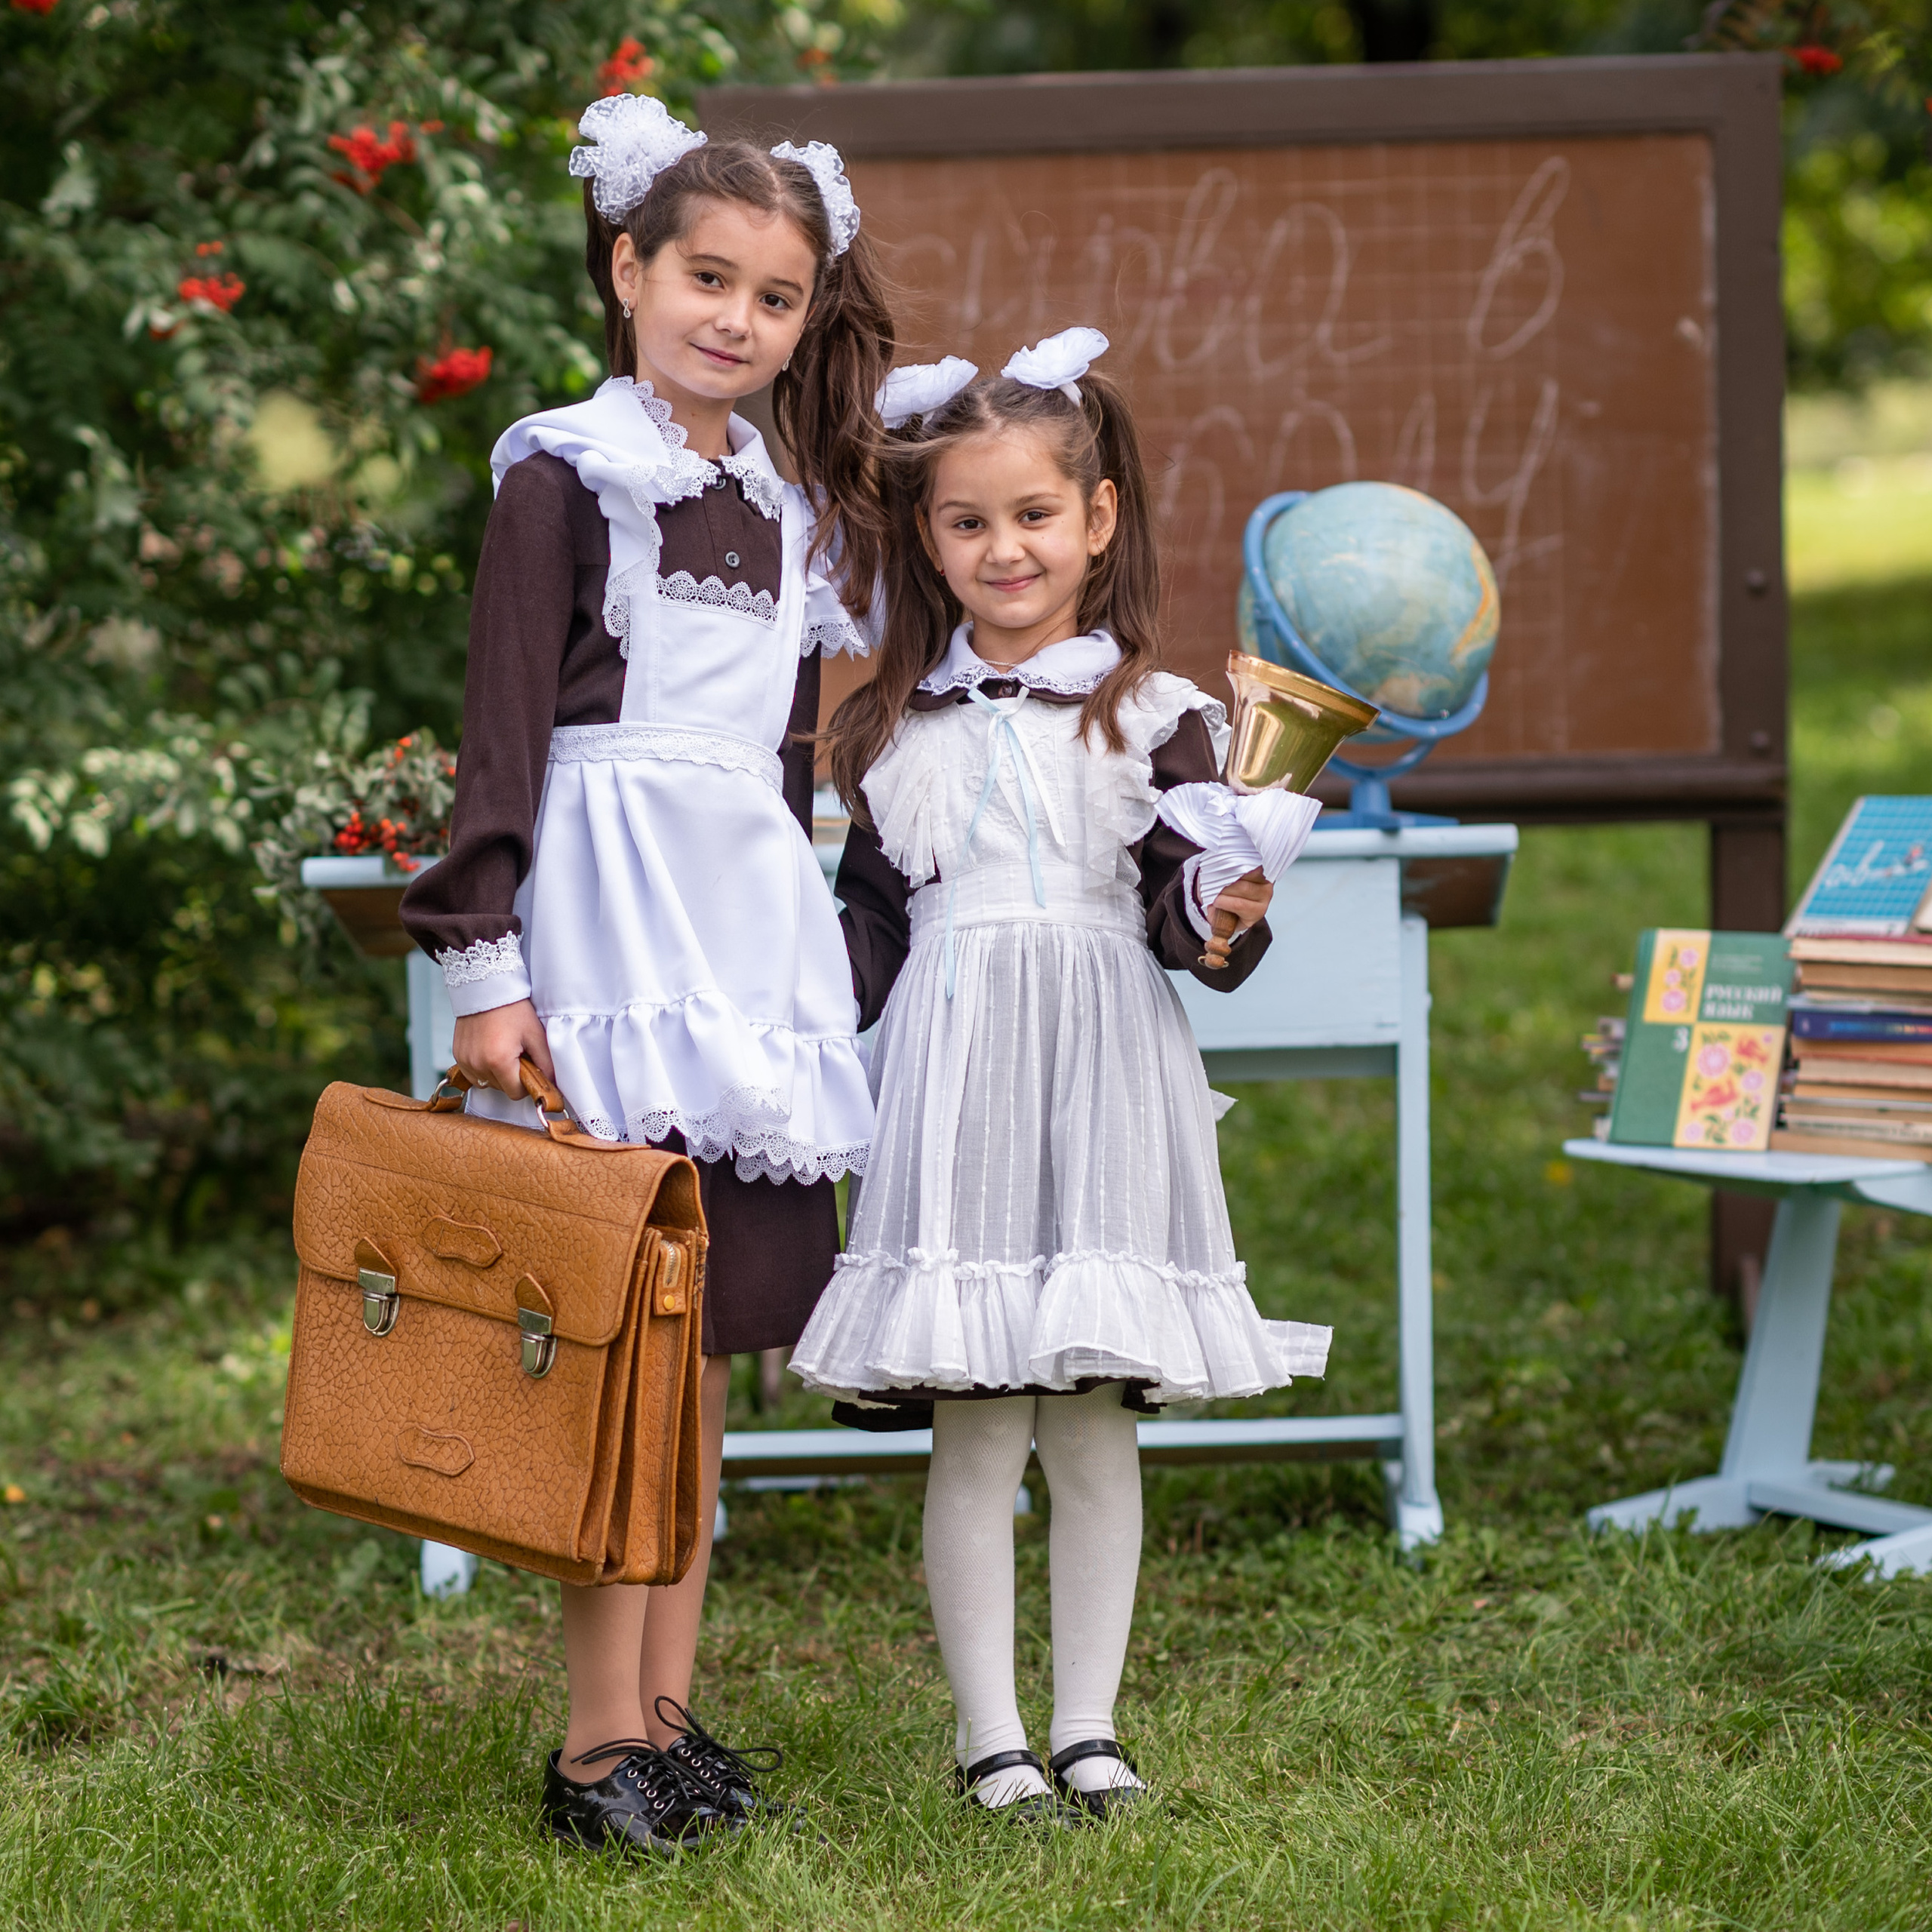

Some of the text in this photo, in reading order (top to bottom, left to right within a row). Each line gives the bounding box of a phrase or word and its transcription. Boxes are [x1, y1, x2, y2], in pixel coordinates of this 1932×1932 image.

[1705, 982, 1783, 1004] РУССКИЙ
[1703, 1000, 1754, 1020] ЯЗЫК
[1672, 1026, 1689, 1053] 3
